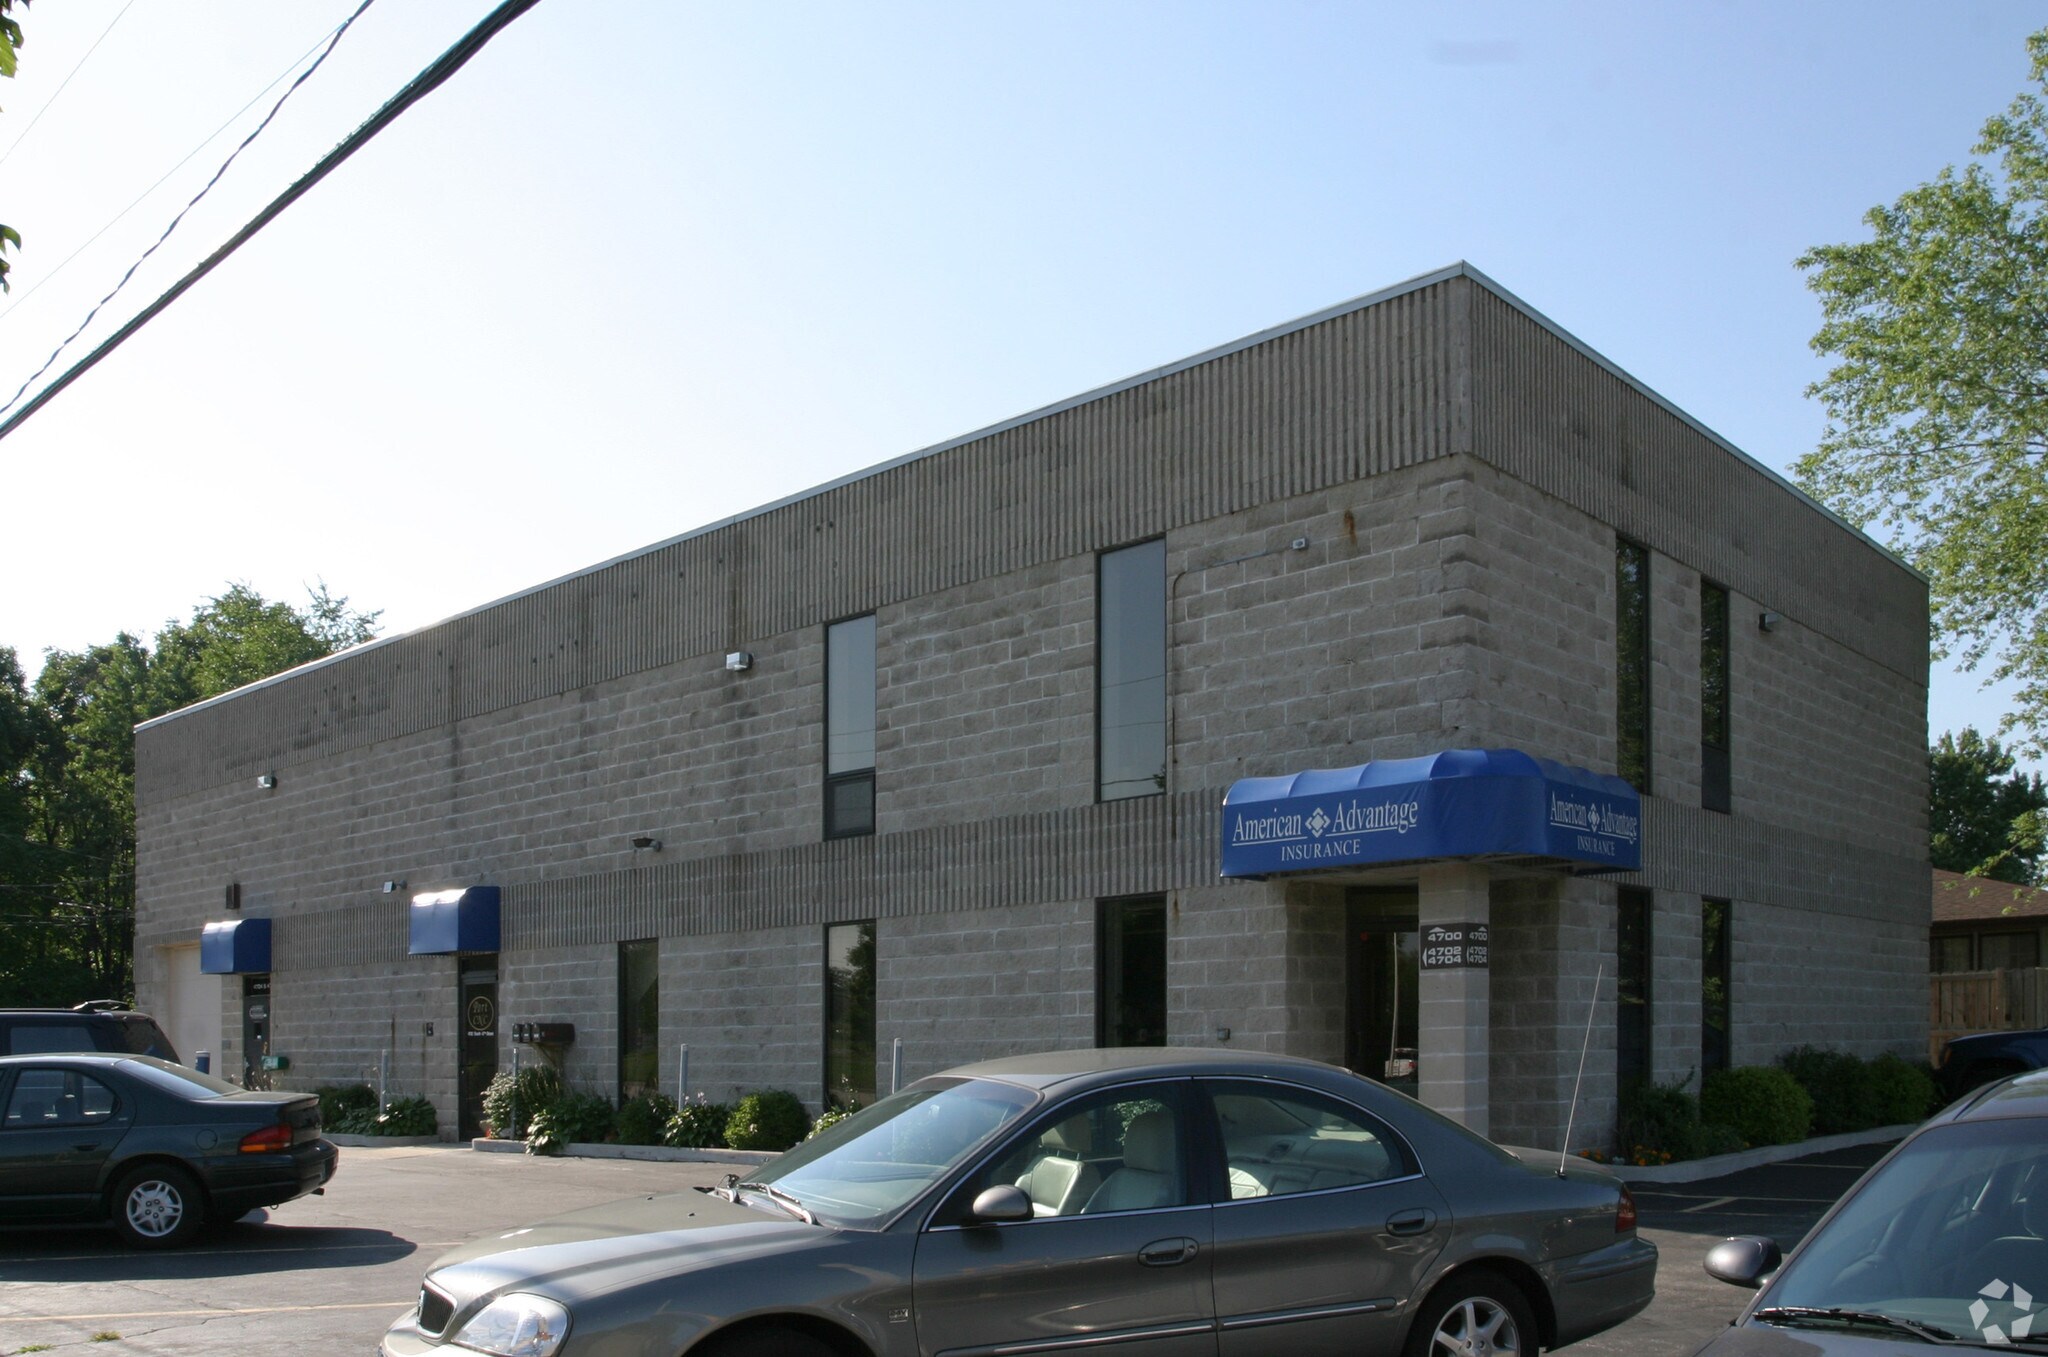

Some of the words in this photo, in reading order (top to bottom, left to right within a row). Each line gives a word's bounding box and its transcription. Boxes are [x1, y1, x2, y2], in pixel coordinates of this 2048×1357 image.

[1232, 808, 1302, 842] American
[1332, 799, 1418, 834] Advantage
[1550, 791, 1588, 827] American
[1600, 803, 1637, 845] Advantage
[1281, 839, 1361, 861] INSURANCE
[1577, 835, 1616, 857] INSURANCE
[1427, 932, 1462, 942] 4700
[1469, 931, 1488, 941] 4700
[1428, 946, 1462, 956] 4702
[1469, 946, 1487, 955] 4702
[1428, 955, 1462, 965] 4704
[1469, 955, 1487, 964] 4704
